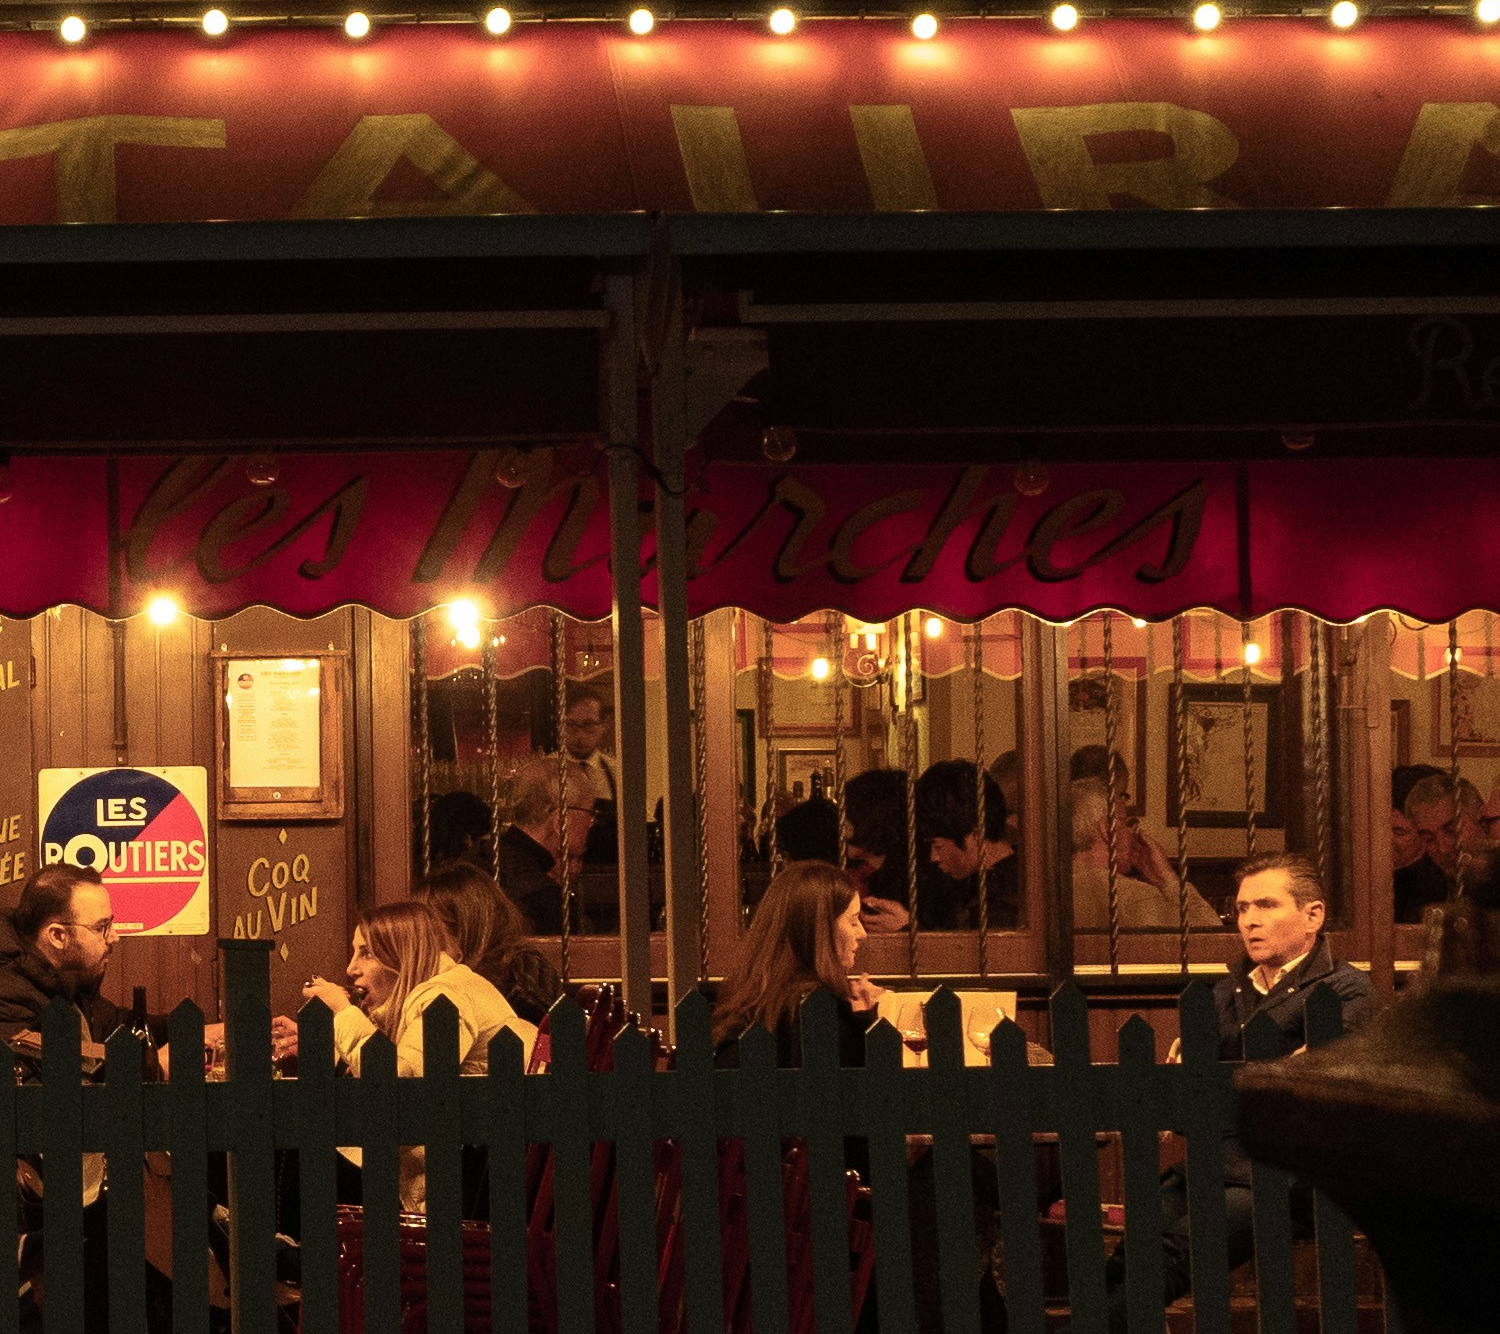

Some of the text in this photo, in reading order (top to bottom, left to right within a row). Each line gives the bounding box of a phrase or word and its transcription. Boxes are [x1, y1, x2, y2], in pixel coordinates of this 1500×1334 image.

[412, 447, 1206, 587] Mrches
[96, 796, 148, 827] LES
[45, 833, 205, 874] ROUTIERS
[247, 853, 310, 897] COQ
[233, 886, 318, 939] AU VIN
